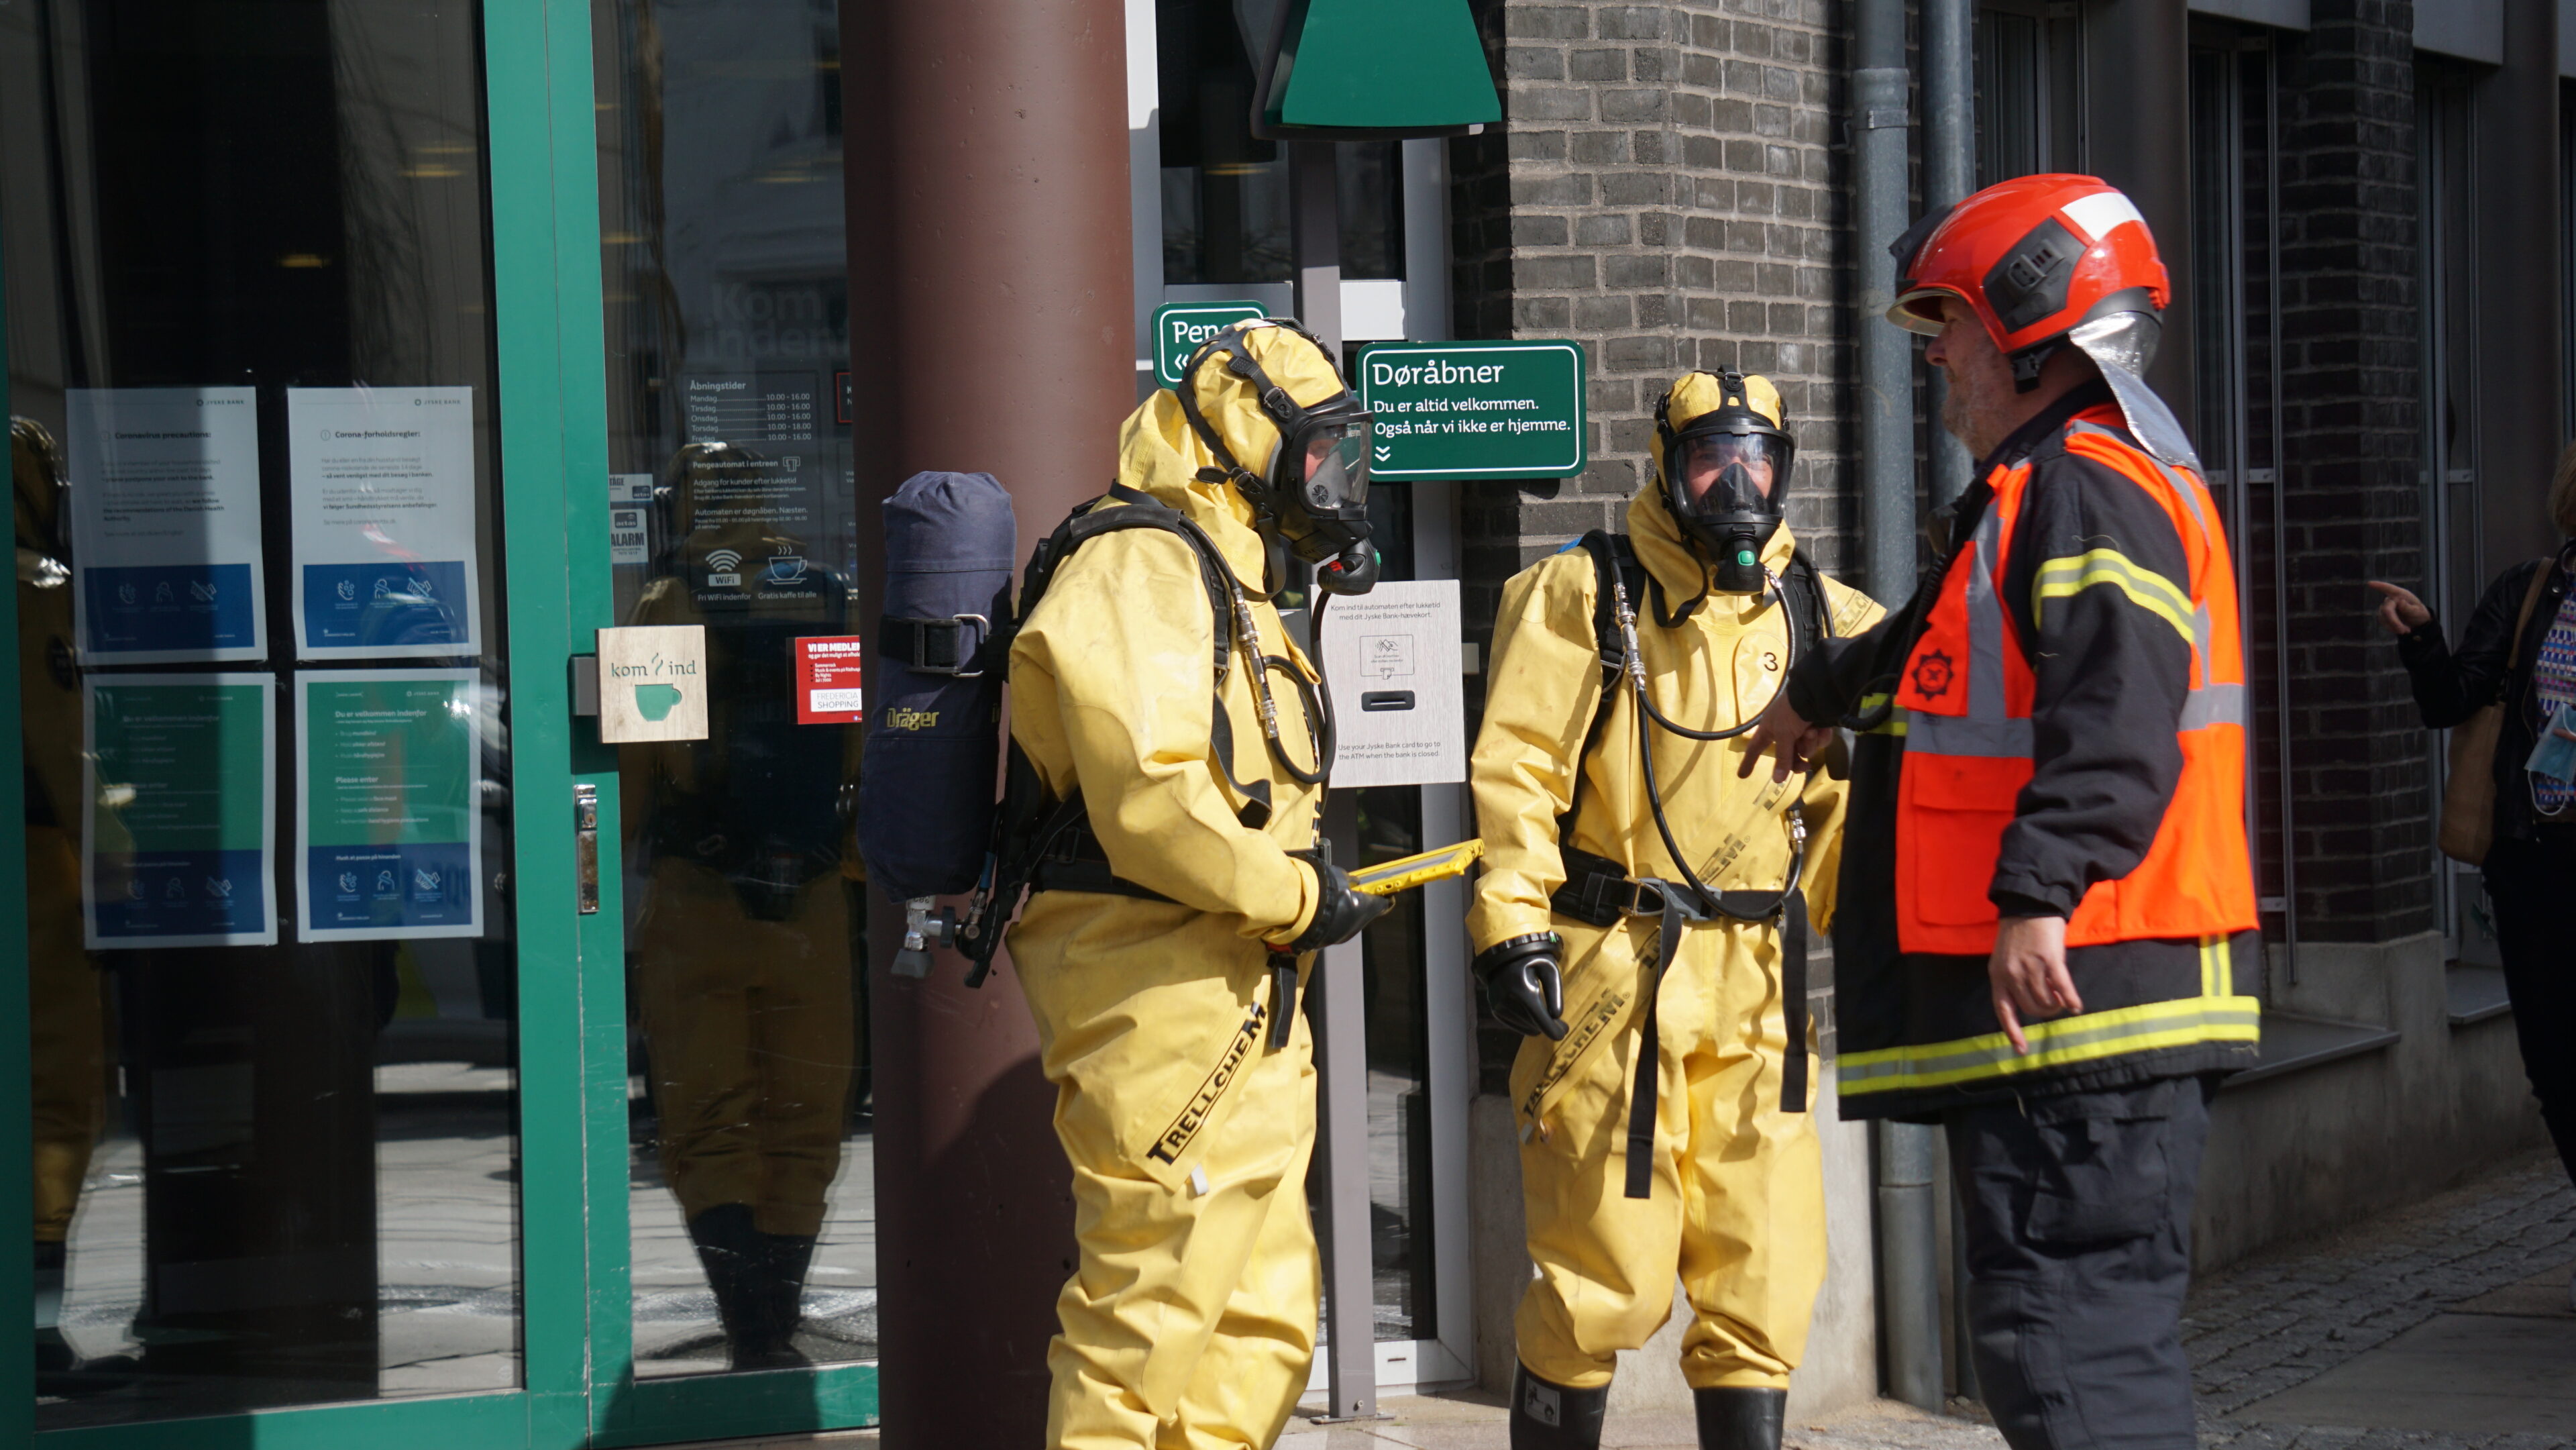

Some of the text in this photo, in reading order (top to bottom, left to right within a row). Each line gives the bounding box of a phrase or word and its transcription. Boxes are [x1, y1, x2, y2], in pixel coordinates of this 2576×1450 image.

[1172, 321, 1230, 344] Pen
[1372, 360, 1504, 387] Døråbner
[690, 380, 746, 391] Åbningstider
[1374, 398, 1539, 413] Du er altid velkommen.
[1375, 419, 1570, 438] Også når vi ikke er hjemme.
[115, 431, 211, 439] Coronavirus precautions:
[335, 430, 421, 439] Corona-forholdsregler:
[693, 461, 746, 470] Pengeautomat
[694, 479, 718, 487] Adgang
[742, 507, 778, 516] døgnåben.
[611, 533, 644, 546] ALARM
[1364, 613, 1382, 621] Jyske
[808, 643, 816, 652] VI
[817, 643, 828, 652] ER
[1763, 652, 1778, 672] 3
[611, 660, 696, 677] kom ind
[817, 692, 858, 701] FREDERICIA
[817, 700, 859, 709] SHOPPING
[887, 707, 939, 731] Dräger
[1366, 743, 1384, 751] Jyske
[1146, 1000, 1267, 1166] TRELLCHEM
